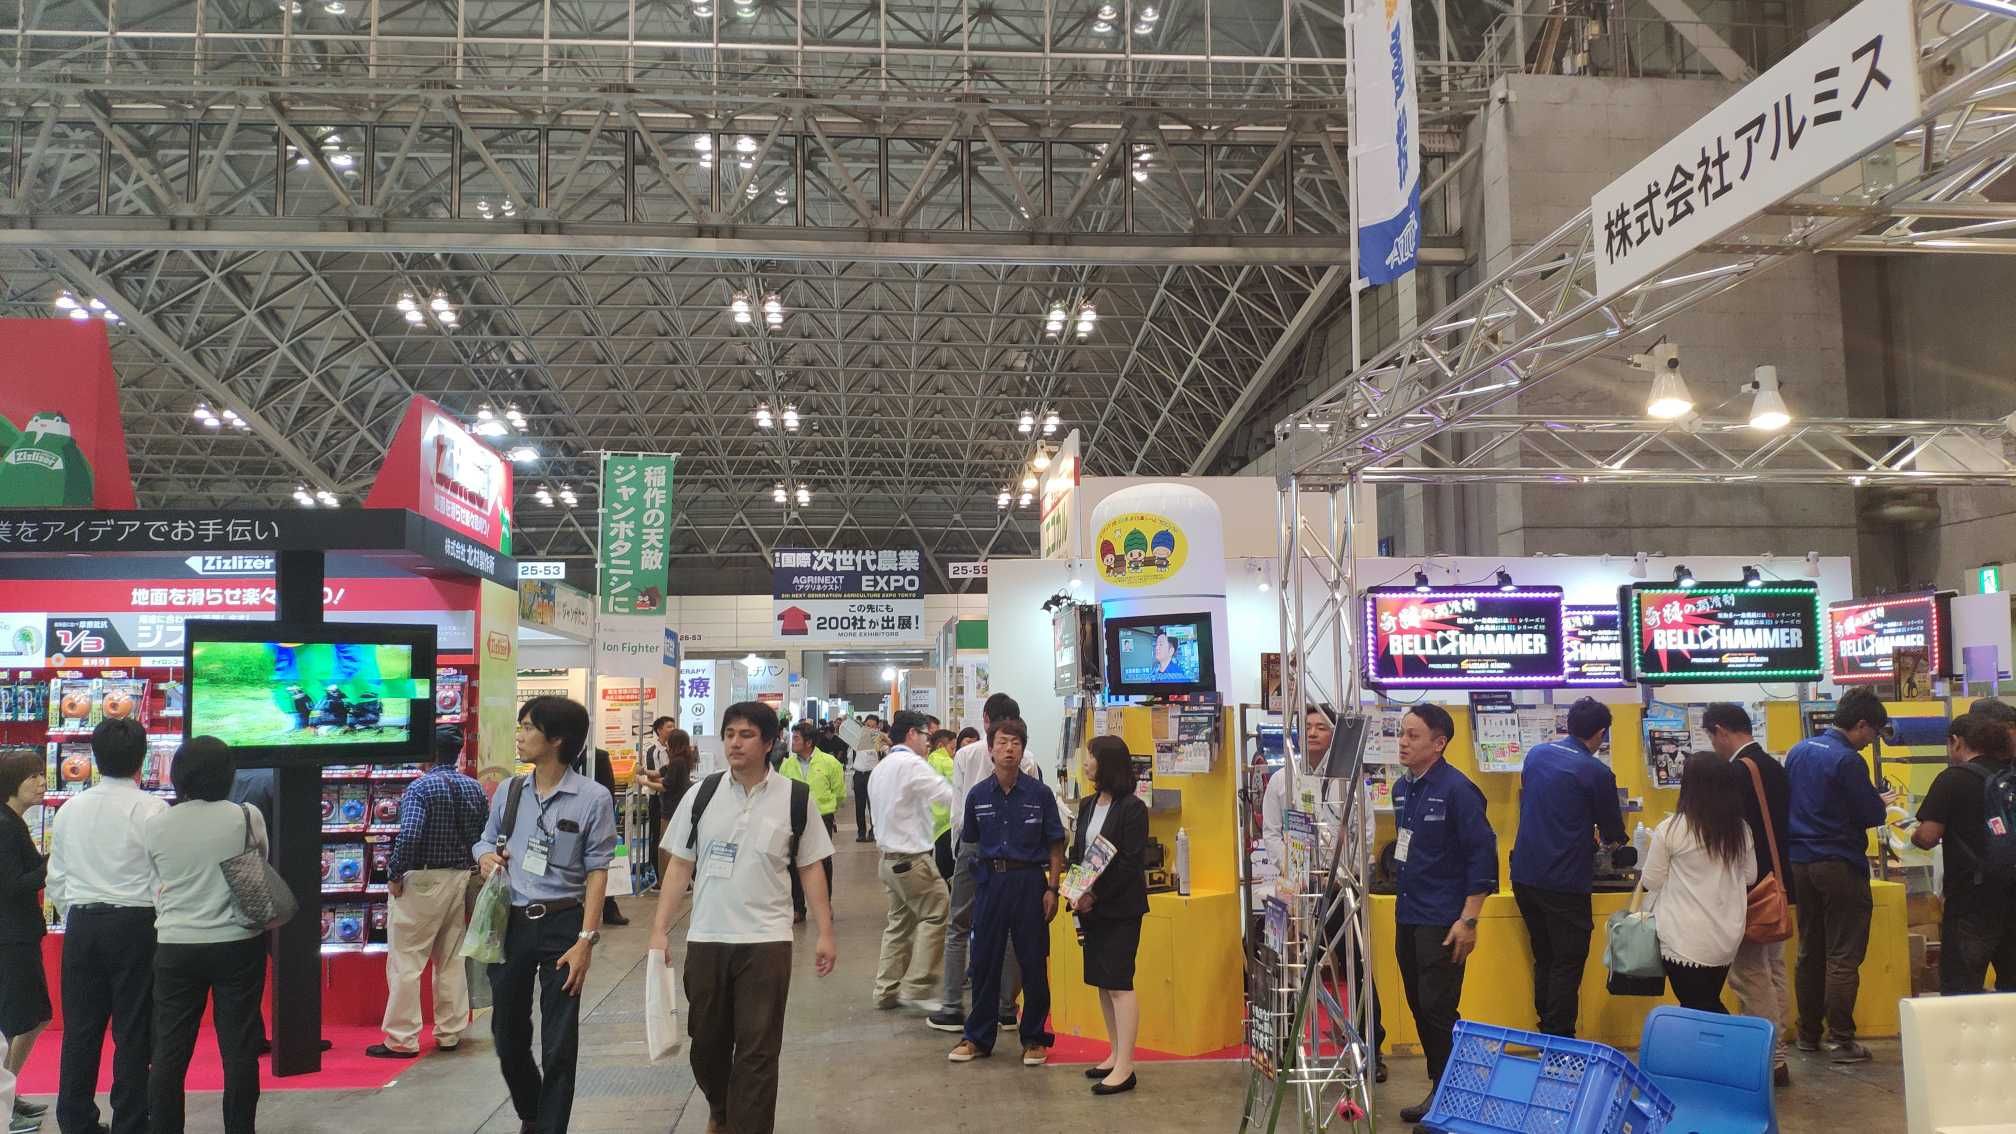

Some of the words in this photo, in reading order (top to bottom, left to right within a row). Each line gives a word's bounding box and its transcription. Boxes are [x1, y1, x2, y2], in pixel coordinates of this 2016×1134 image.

[1604, 32, 1891, 265] 株式会社アルミス
[640, 466, 667, 570] 稲作の天敵
[608, 464, 638, 613] ジャンボタニシに
[203, 556, 275, 571] Zizlizer
[521, 565, 561, 576] 25-53
[952, 565, 988, 575] 25-59
[792, 575, 845, 585] AGRINEXT
[861, 575, 920, 592] EXPO
[849, 604, 894, 613] この先にも
[816, 615, 920, 630] 200社が出展!
[56, 629, 104, 653] 1/3
[1389, 633, 1437, 655] BELL
[1459, 633, 1547, 655] HAMMER
[1653, 628, 1701, 650] BELL
[1719, 627, 1803, 650] HAMMER
[622, 642, 660, 656] Fighter
[1840, 639, 1865, 657] BELL
